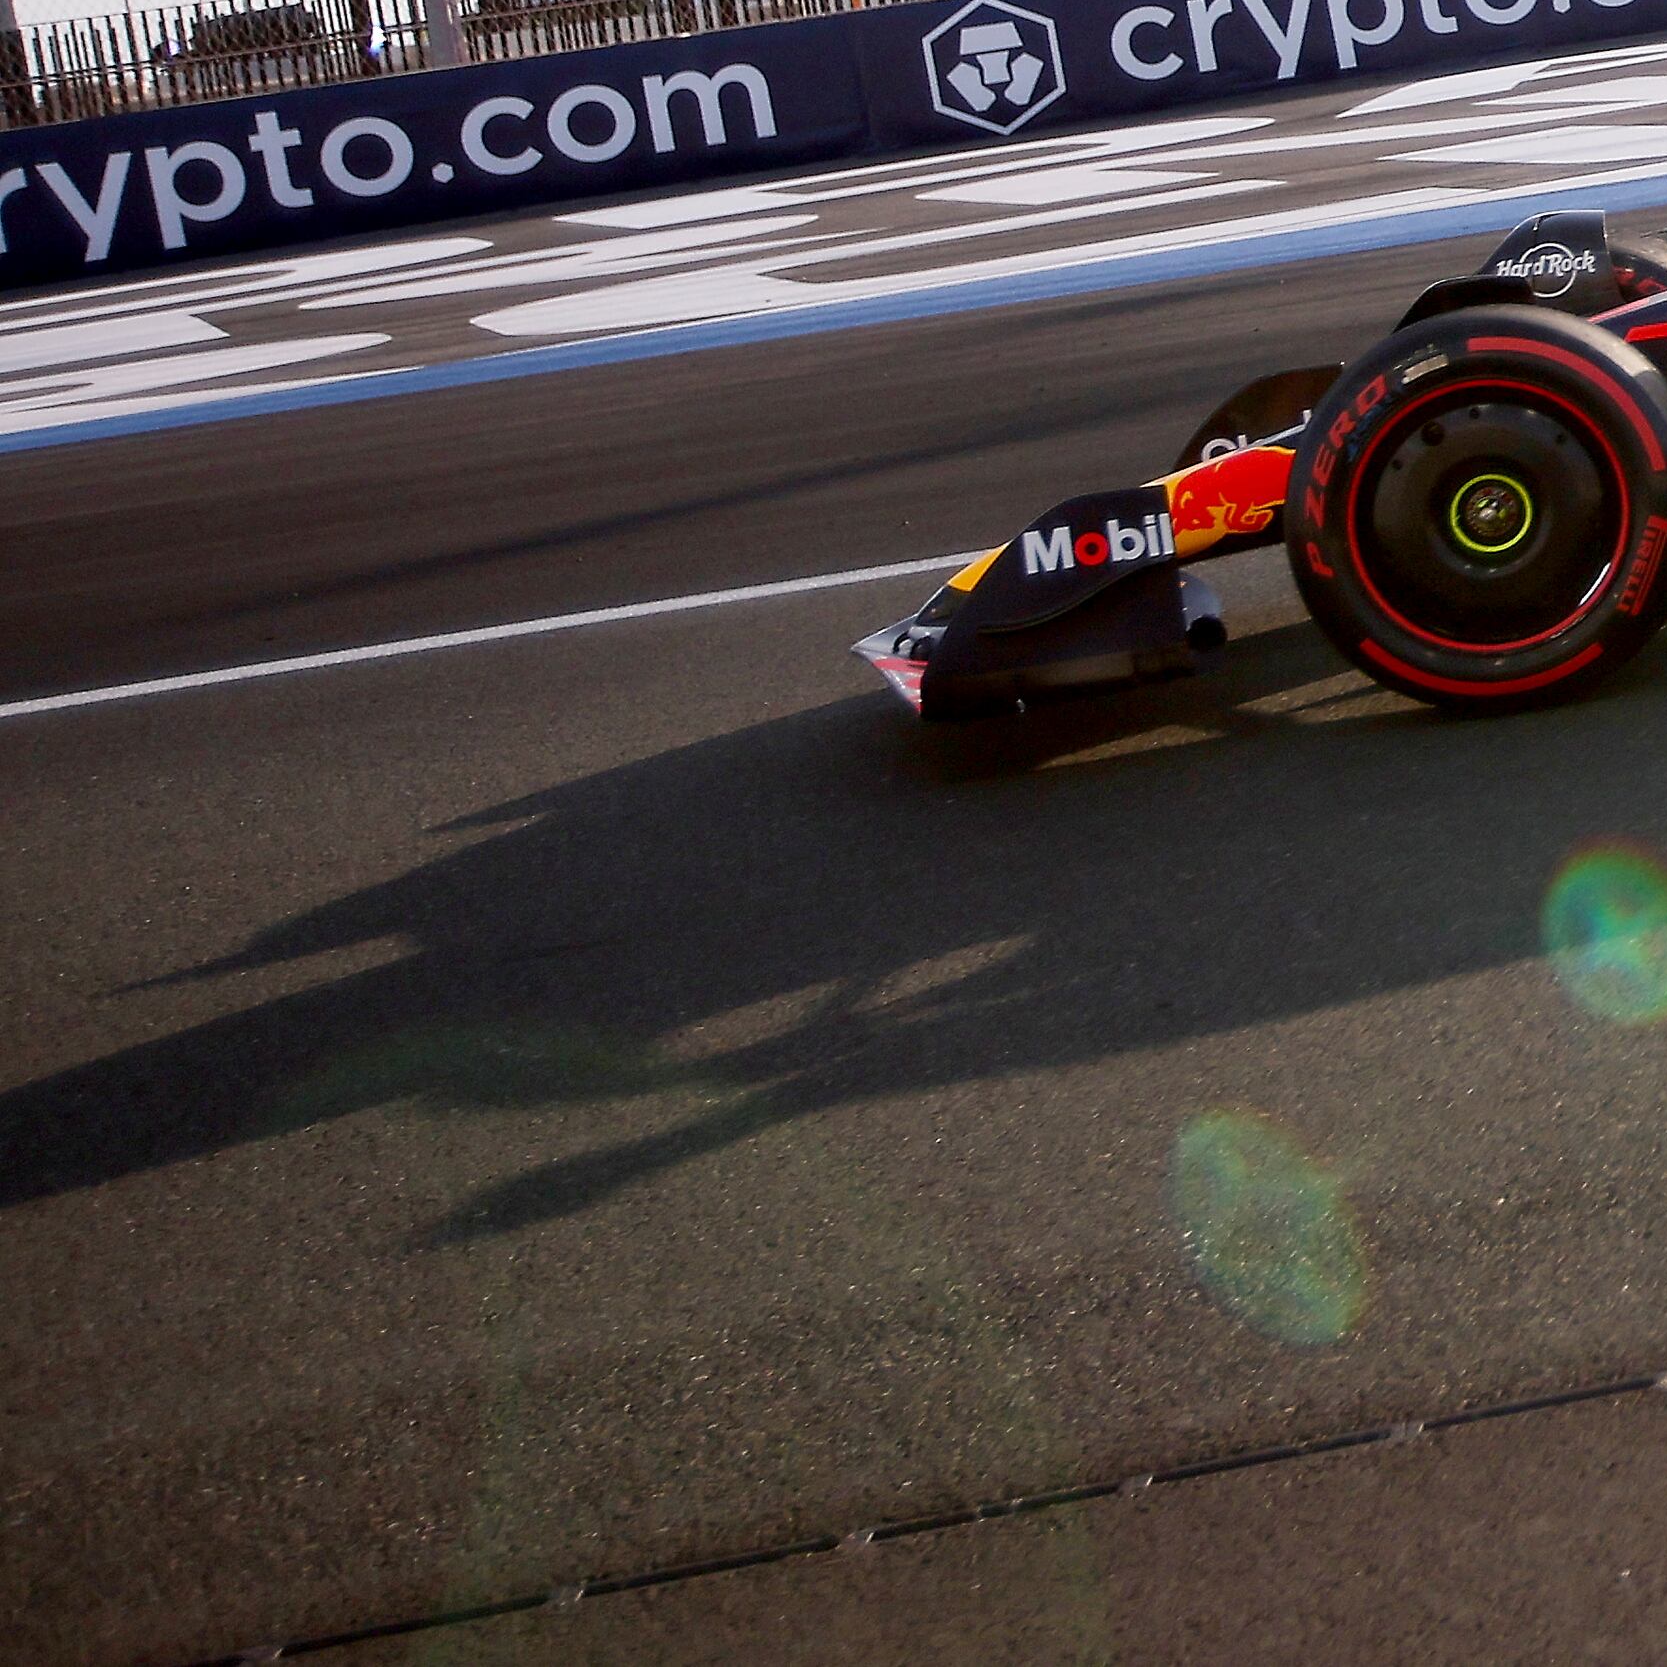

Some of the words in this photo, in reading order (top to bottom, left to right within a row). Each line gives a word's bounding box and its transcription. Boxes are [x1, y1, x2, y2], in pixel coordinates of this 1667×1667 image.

[0, 65, 776, 261] rypto.com
[1496, 255, 1545, 278] Hard
[1546, 250, 1596, 277] Rock
[1304, 374, 1388, 529] ZERO
[1023, 513, 1175, 575] Mobil
